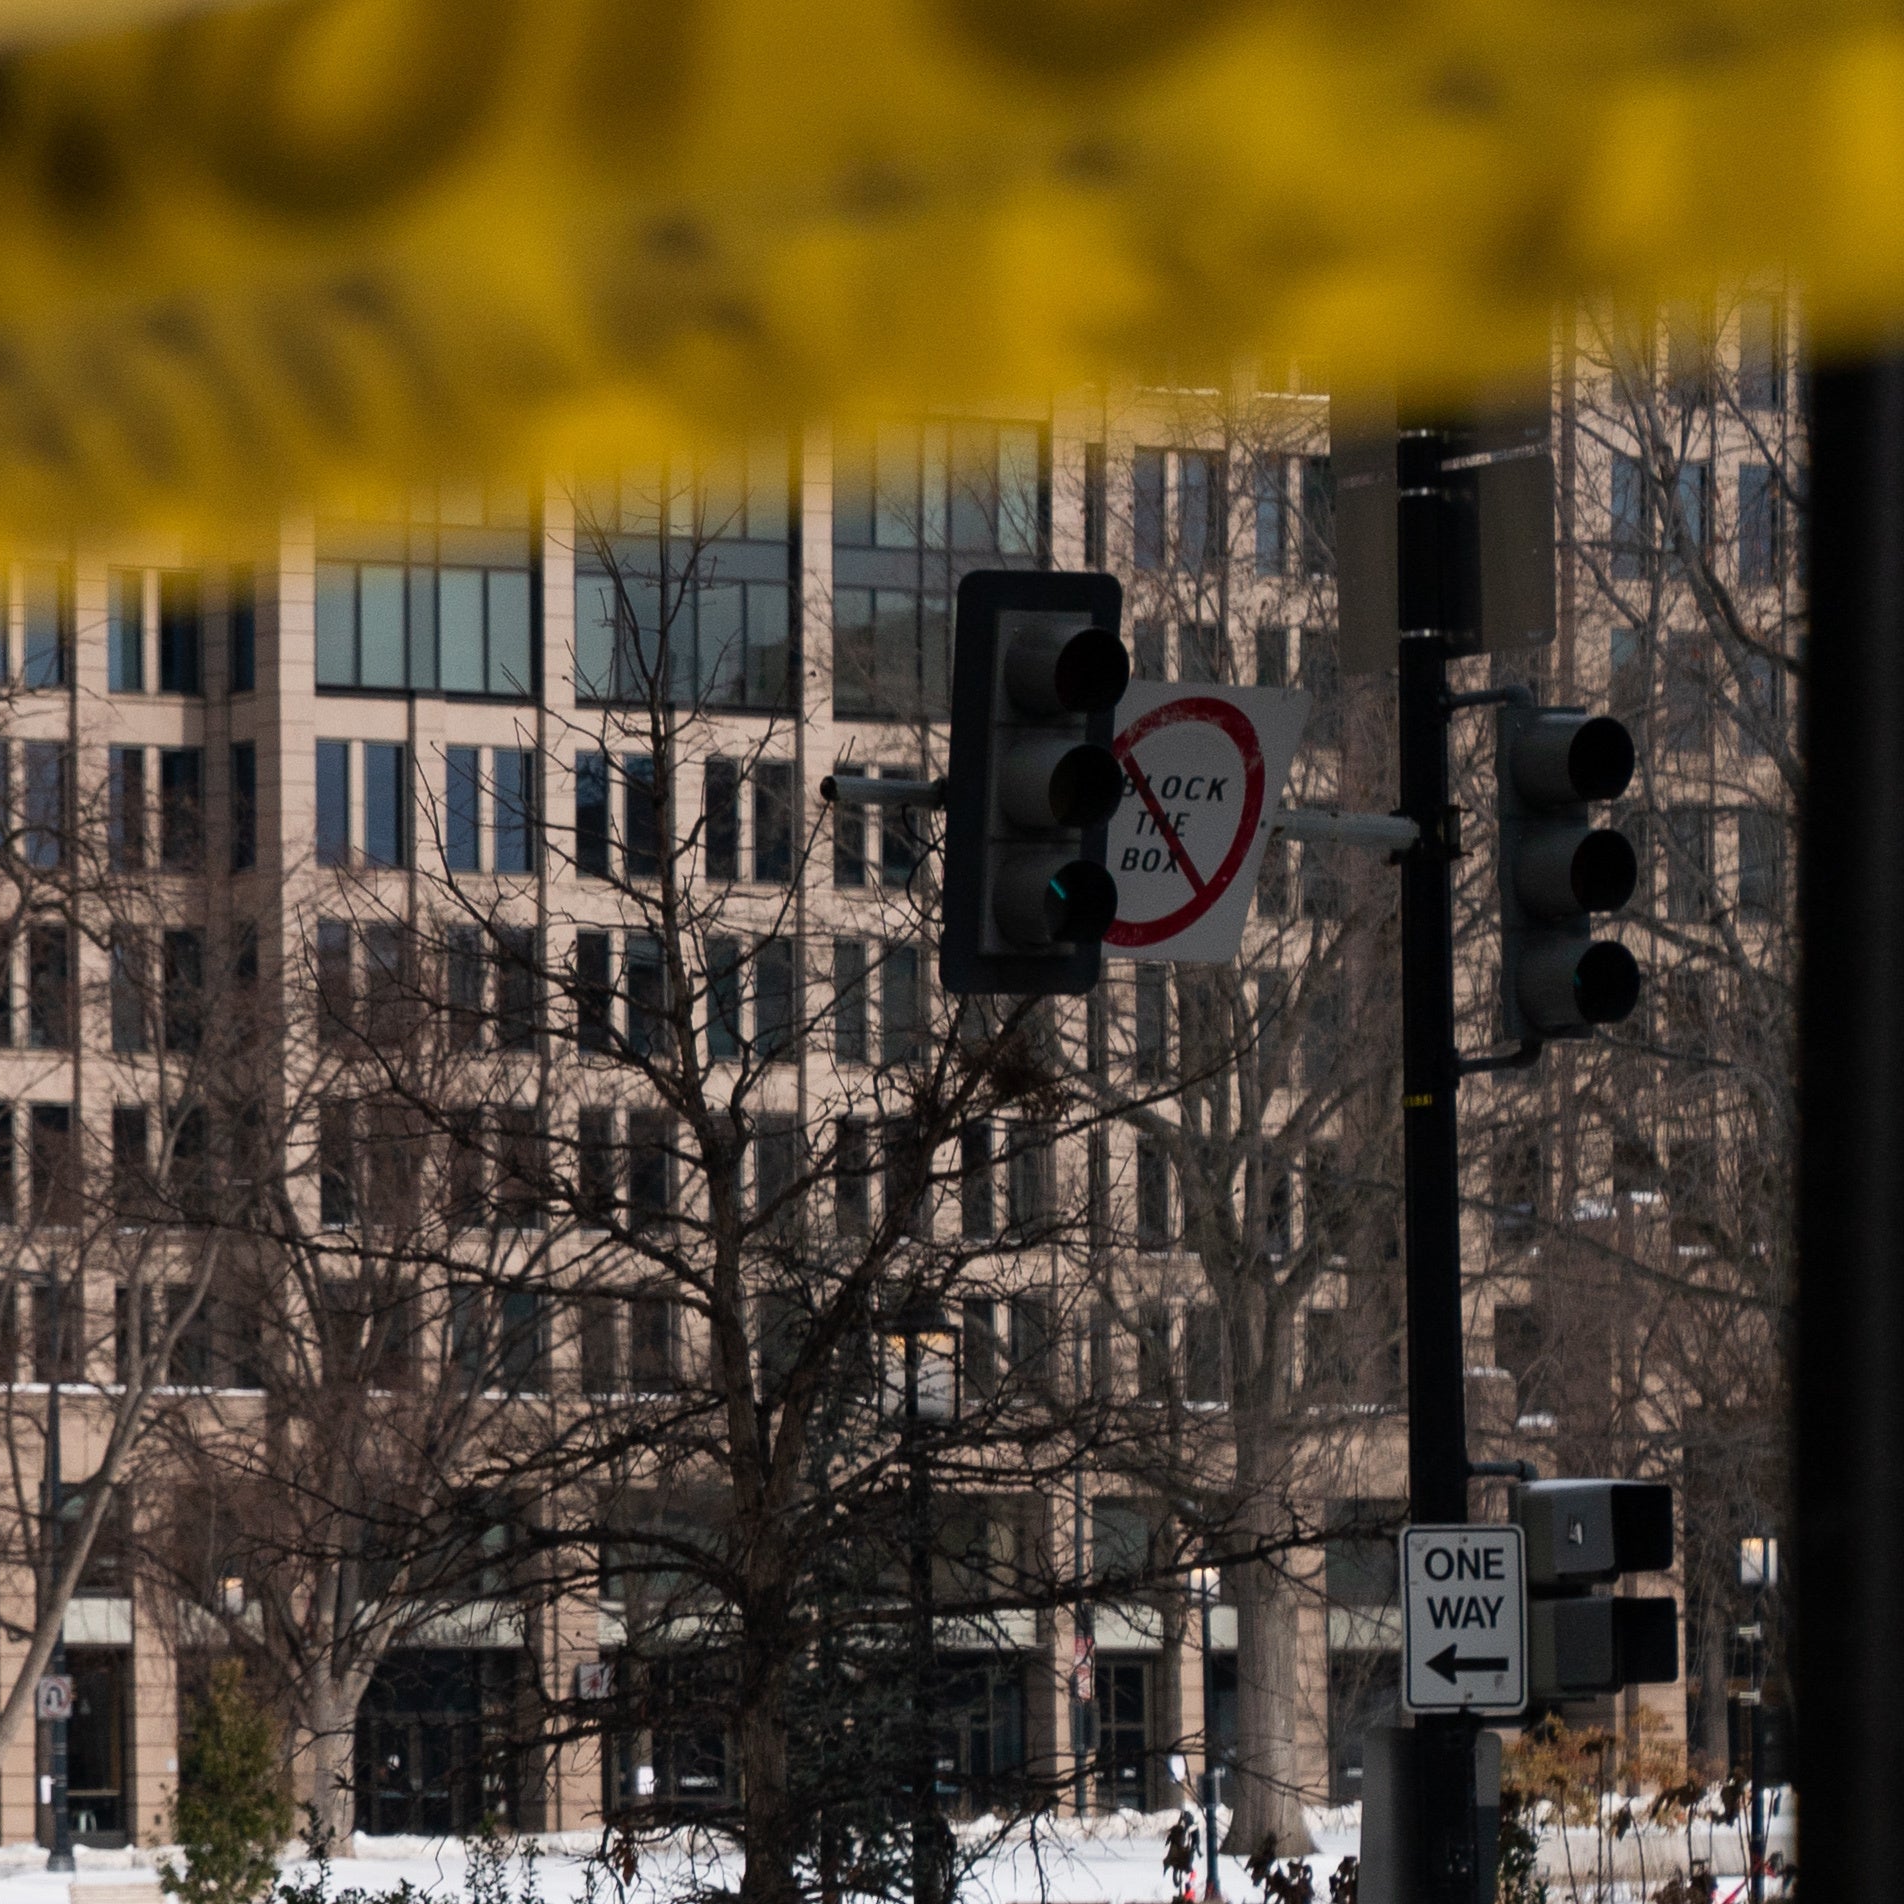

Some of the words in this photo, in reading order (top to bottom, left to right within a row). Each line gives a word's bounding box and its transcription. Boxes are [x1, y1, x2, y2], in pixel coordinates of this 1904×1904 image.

[1136, 811, 1190, 837] THE
[1120, 847, 1178, 874] BOX
[1425, 1547, 1505, 1581] ONE
[1426, 1596, 1505, 1630] WAY
